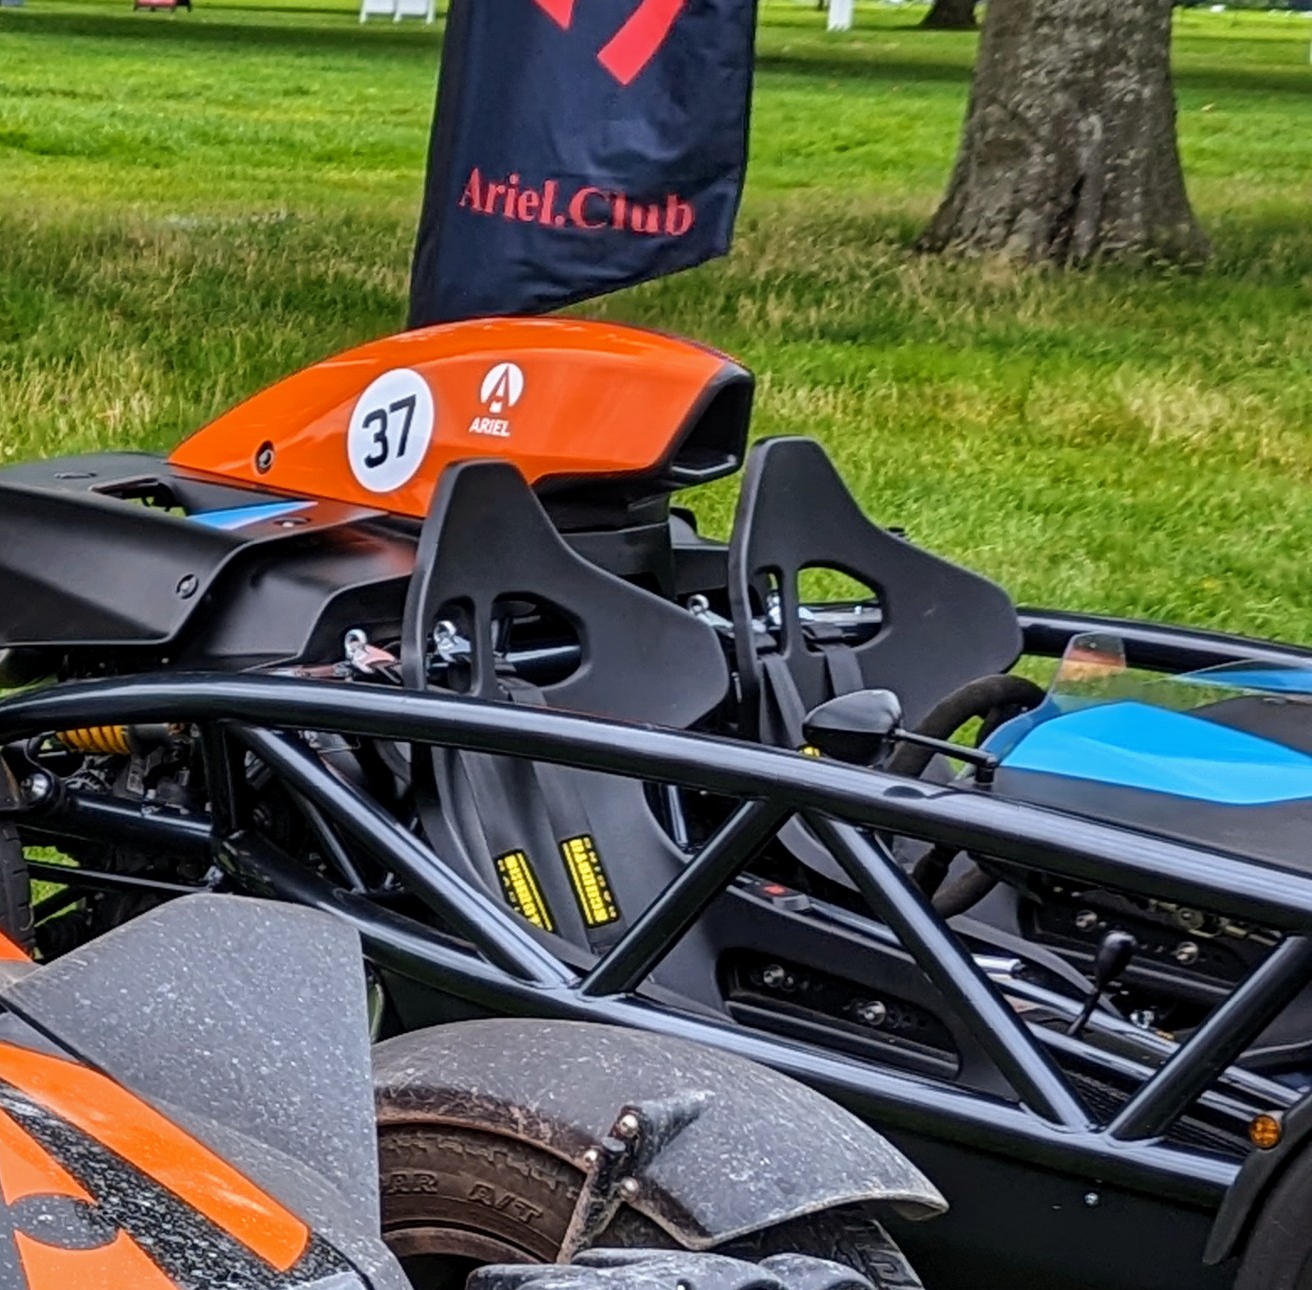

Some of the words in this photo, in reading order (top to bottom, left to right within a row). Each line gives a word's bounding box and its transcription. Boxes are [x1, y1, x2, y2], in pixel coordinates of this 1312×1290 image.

[458, 167, 696, 236] Ariel.Club
[362, 393, 417, 469] 37
[469, 417, 511, 438] ARIEL
